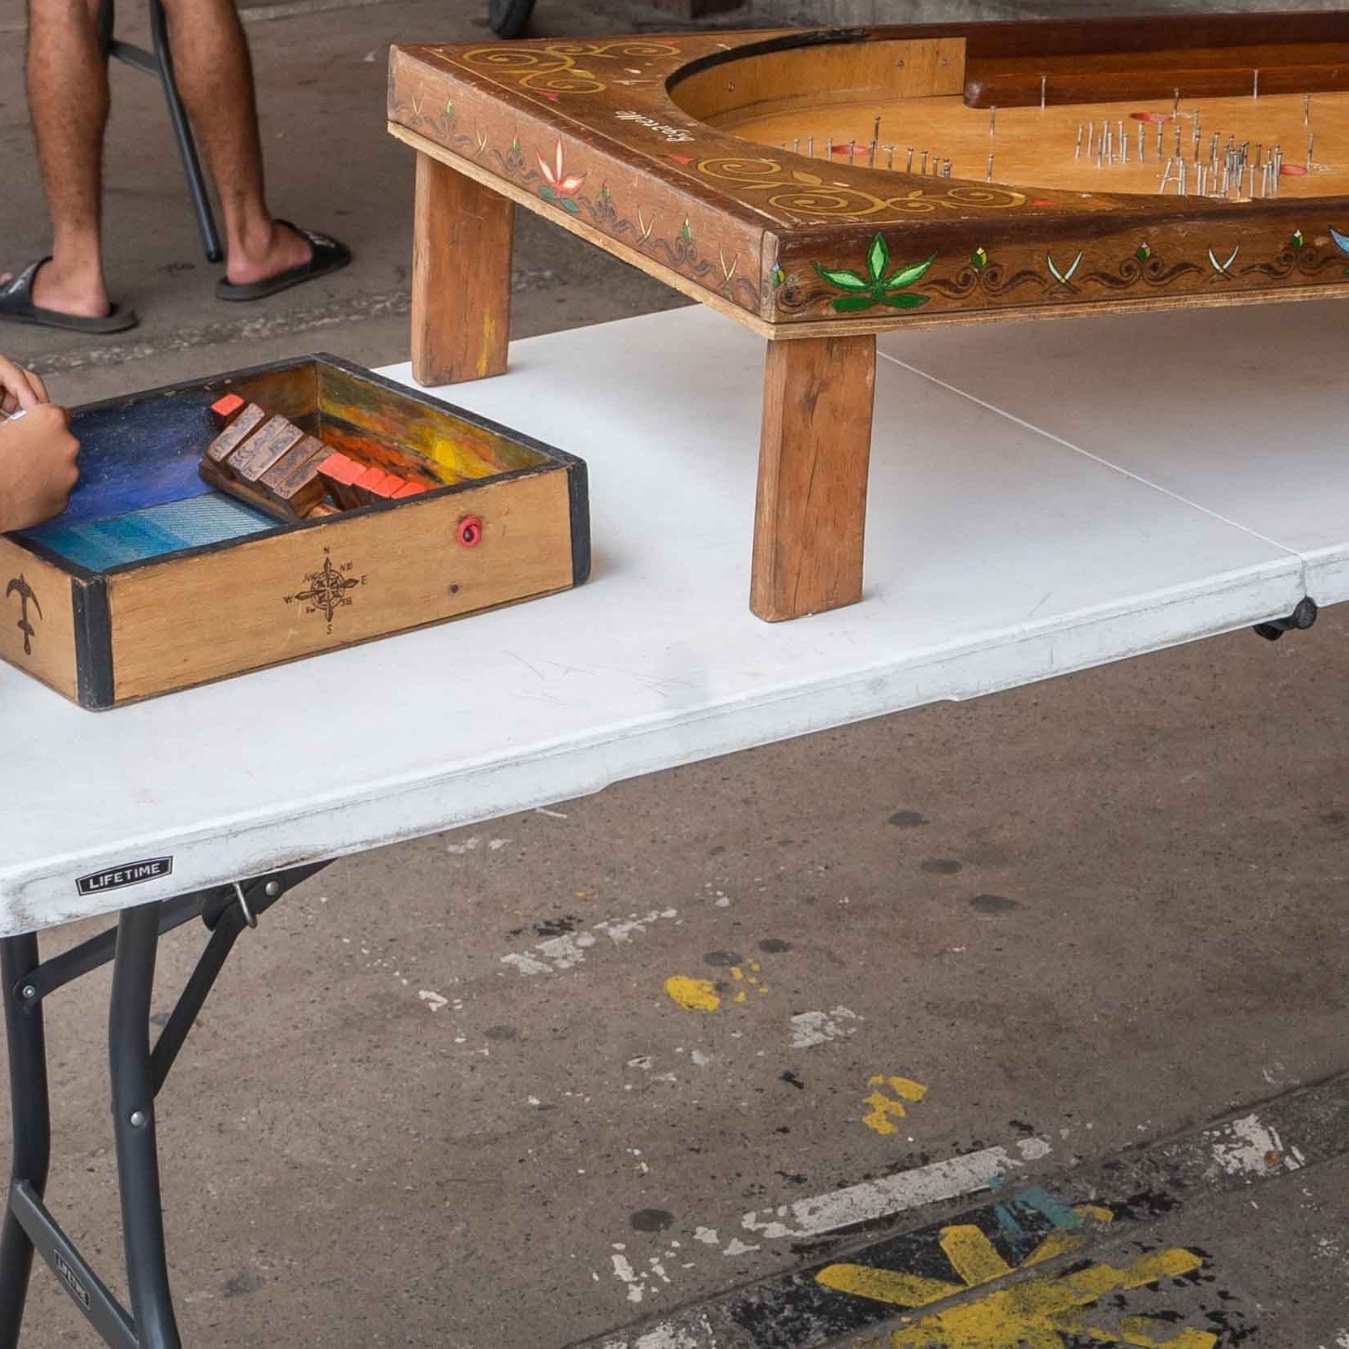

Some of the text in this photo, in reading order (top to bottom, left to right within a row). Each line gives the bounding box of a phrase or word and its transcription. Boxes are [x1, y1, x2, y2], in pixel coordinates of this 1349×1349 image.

[360, 575, 367, 585] E
[283, 595, 293, 604] W
[326, 624, 332, 635] S
[88, 862, 161, 890] LIFETIME
